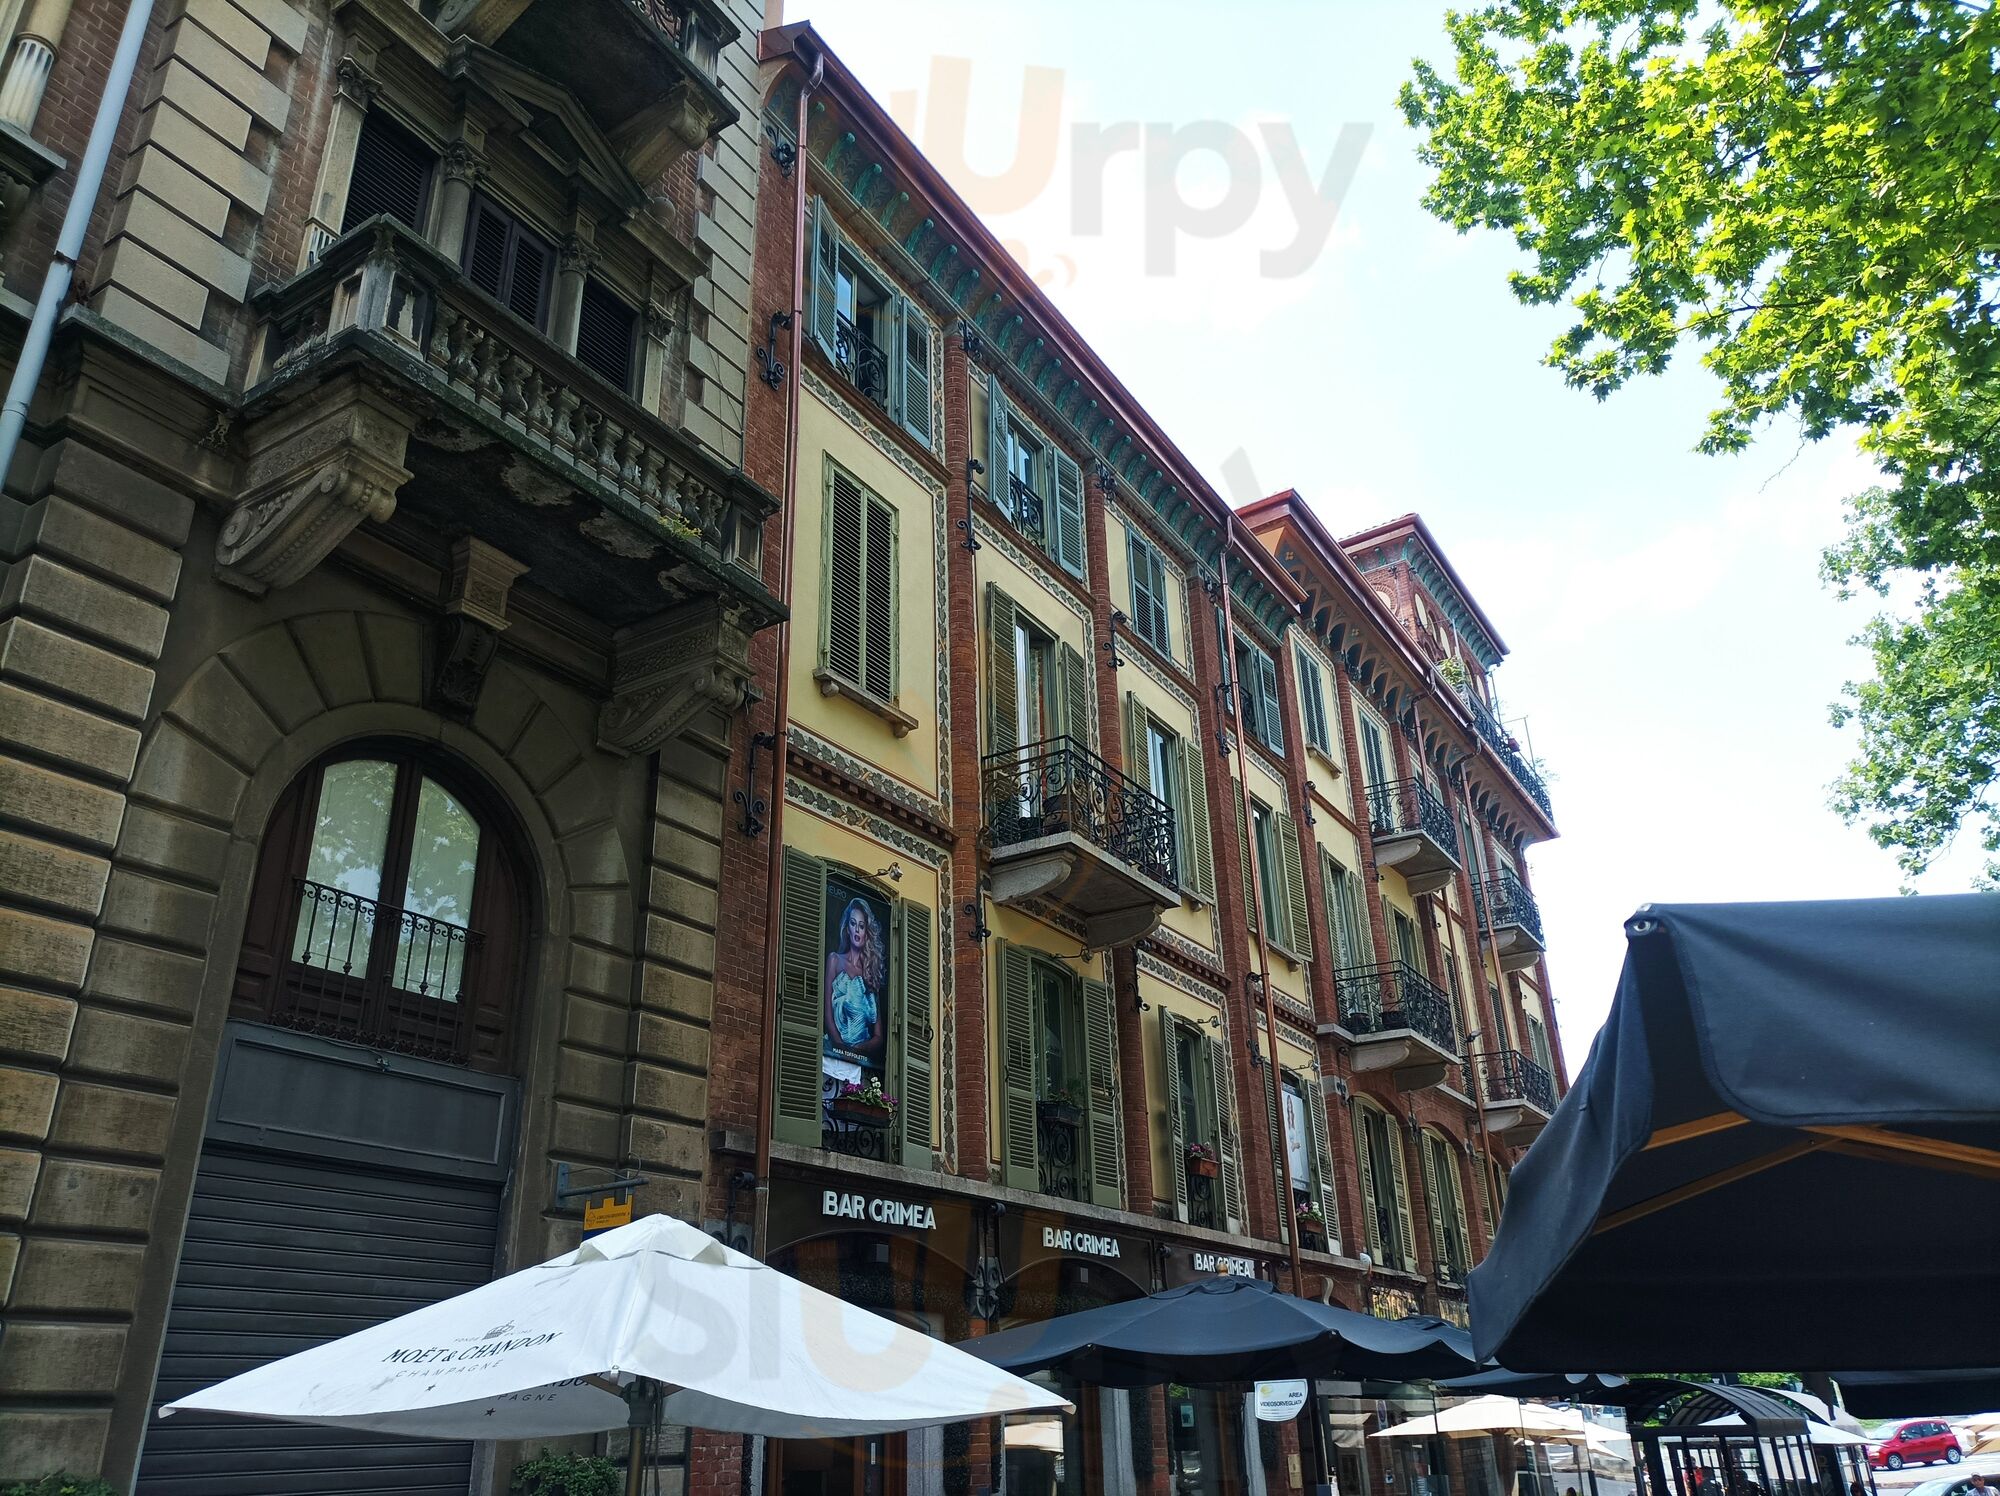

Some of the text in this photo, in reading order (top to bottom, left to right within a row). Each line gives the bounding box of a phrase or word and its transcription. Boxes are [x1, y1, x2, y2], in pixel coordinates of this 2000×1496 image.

[822, 1190, 937, 1230] BAR CRIMEA
[1042, 1226, 1121, 1258] BAR CRIMEA
[1194, 1253, 1216, 1273] BAR
[382, 1347, 444, 1363] MOËT
[443, 1351, 457, 1362] &
[459, 1332, 563, 1360] CHANDON
[394, 1359, 504, 1378] CHAMPAGNE
